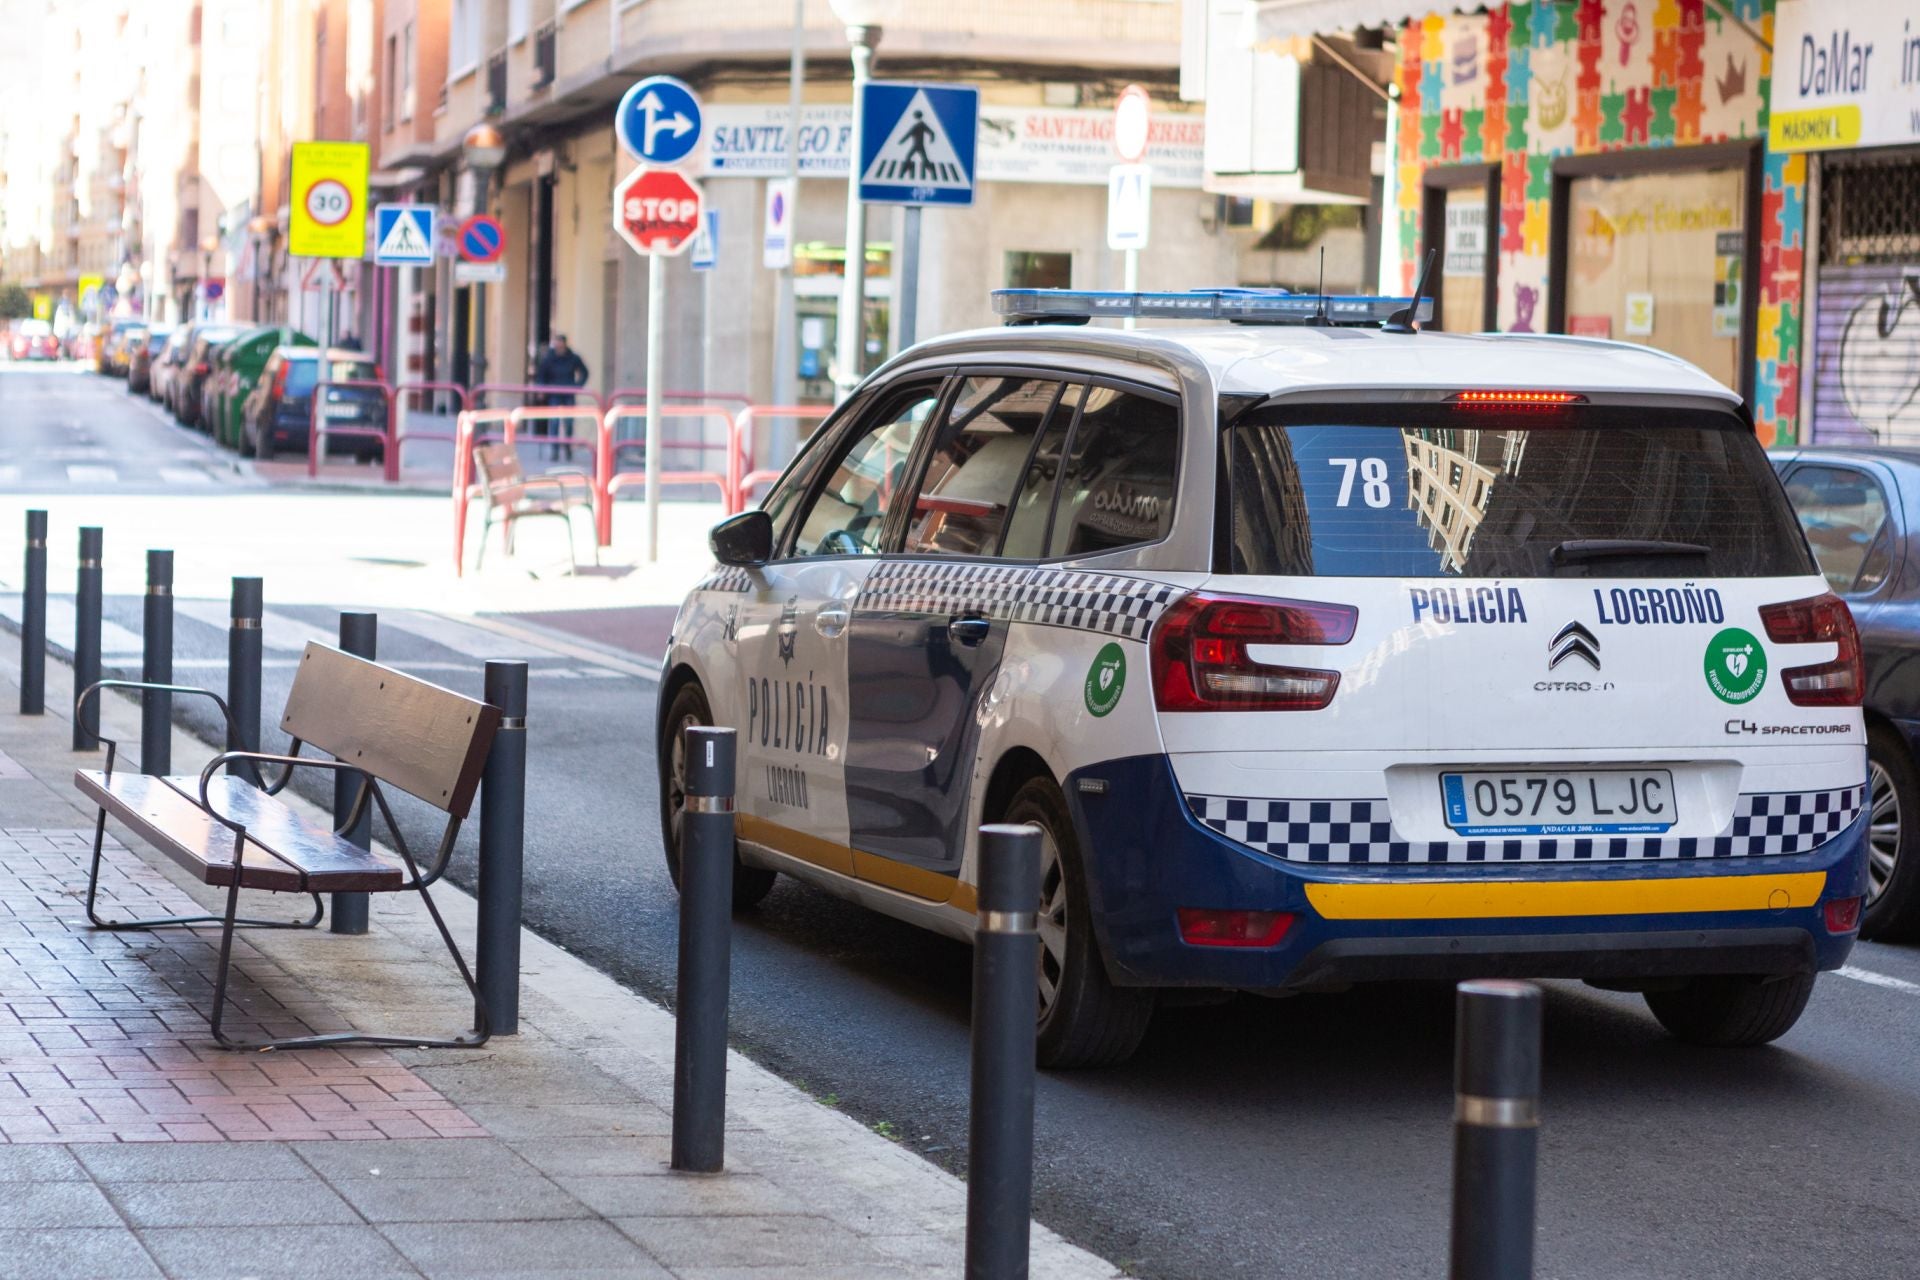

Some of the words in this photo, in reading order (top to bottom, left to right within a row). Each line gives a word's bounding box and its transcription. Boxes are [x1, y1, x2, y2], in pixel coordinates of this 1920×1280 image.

[1799, 30, 1873, 97] DaMar
[712, 126, 830, 153] SANTIGO
[1025, 115, 1113, 141] SANTIAG
[1147, 121, 1205, 144] ERRE
[314, 193, 342, 211] 30
[624, 197, 697, 222] STOP
[1329, 457, 1391, 509] 78
[1409, 581, 1528, 625] POLICÍA
[1593, 582, 1725, 625] LOGROÑO
[748, 670, 829, 757] POLICÍA
[1725, 719, 1758, 735] C4
[1762, 724, 1851, 735] SPACETOURER
[766, 763, 809, 810] LOGROÑO
[1474, 778, 1577, 817] 0579
[1588, 777, 1664, 816] LJC
[1453, 804, 1462, 816] E
[1540, 825, 1577, 834] ANDACAR
